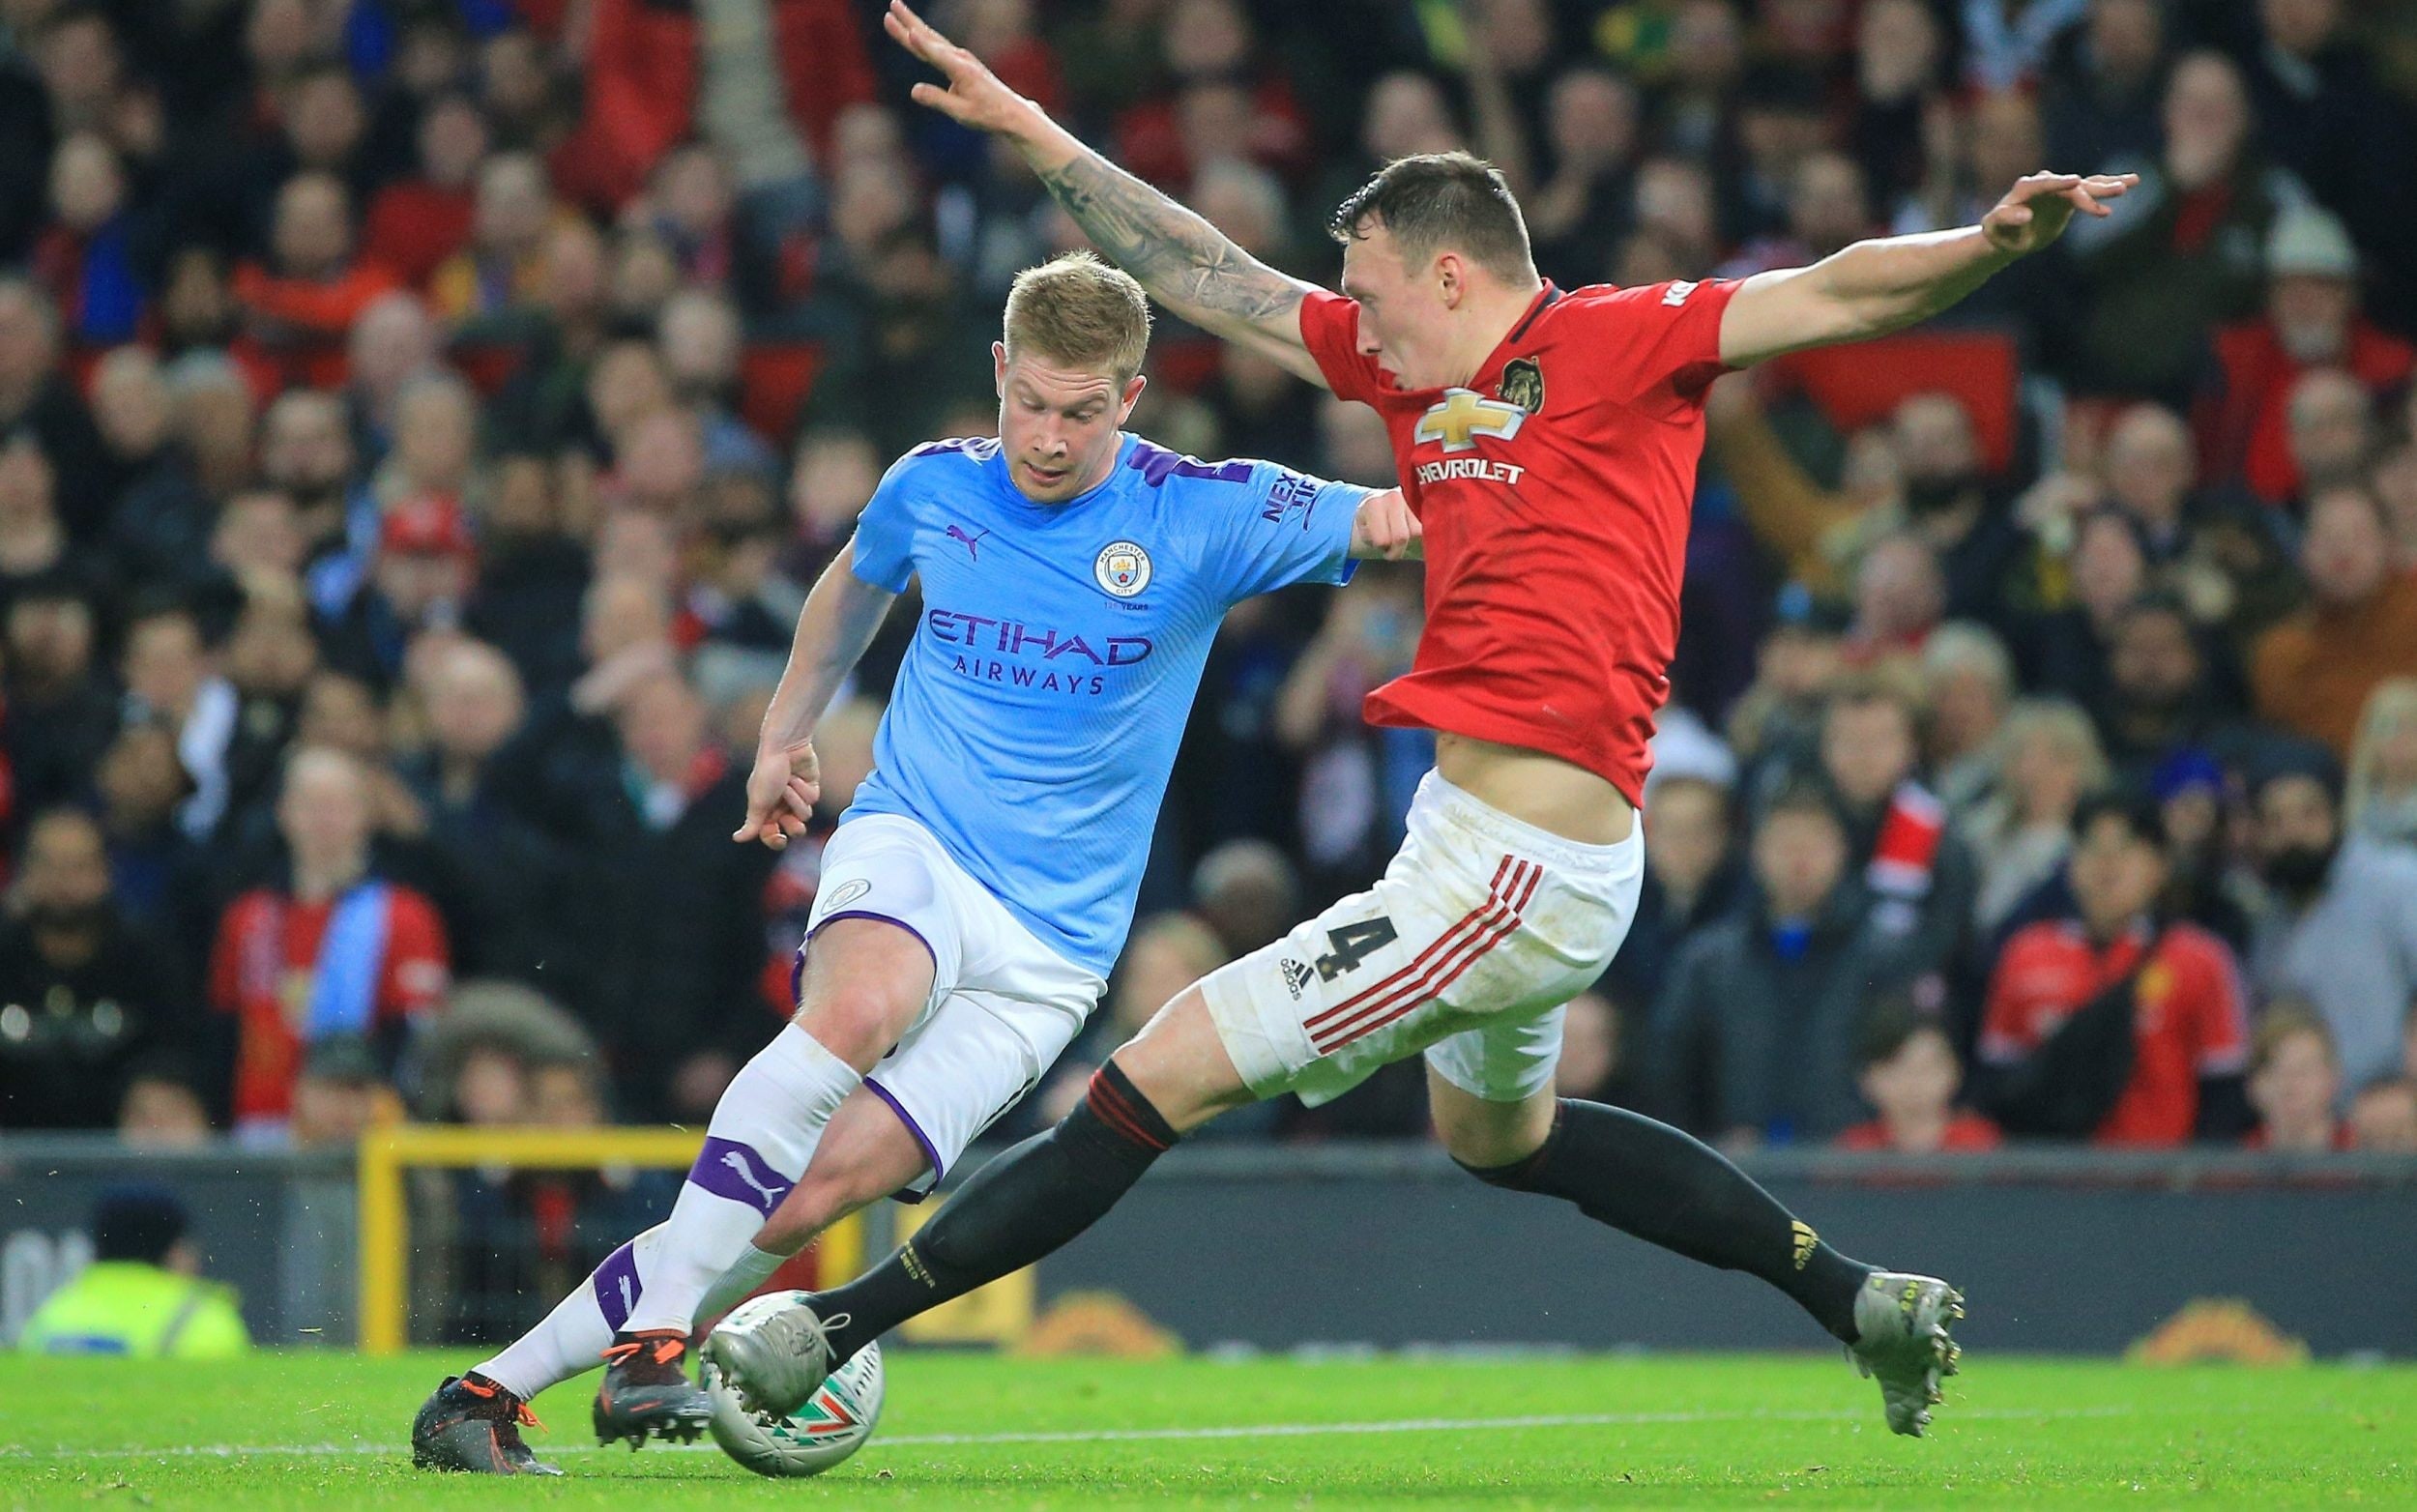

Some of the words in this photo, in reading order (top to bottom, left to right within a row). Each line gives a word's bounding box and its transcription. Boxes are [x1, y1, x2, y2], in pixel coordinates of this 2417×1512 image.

[1099, 544, 1146, 564] MANCHESTER
[929, 608, 1153, 666] ETIHAD
[953, 654, 1105, 695] AIRWAYS
[1316, 916, 1398, 983] 4
[1280, 958, 1301, 1001] adidas
